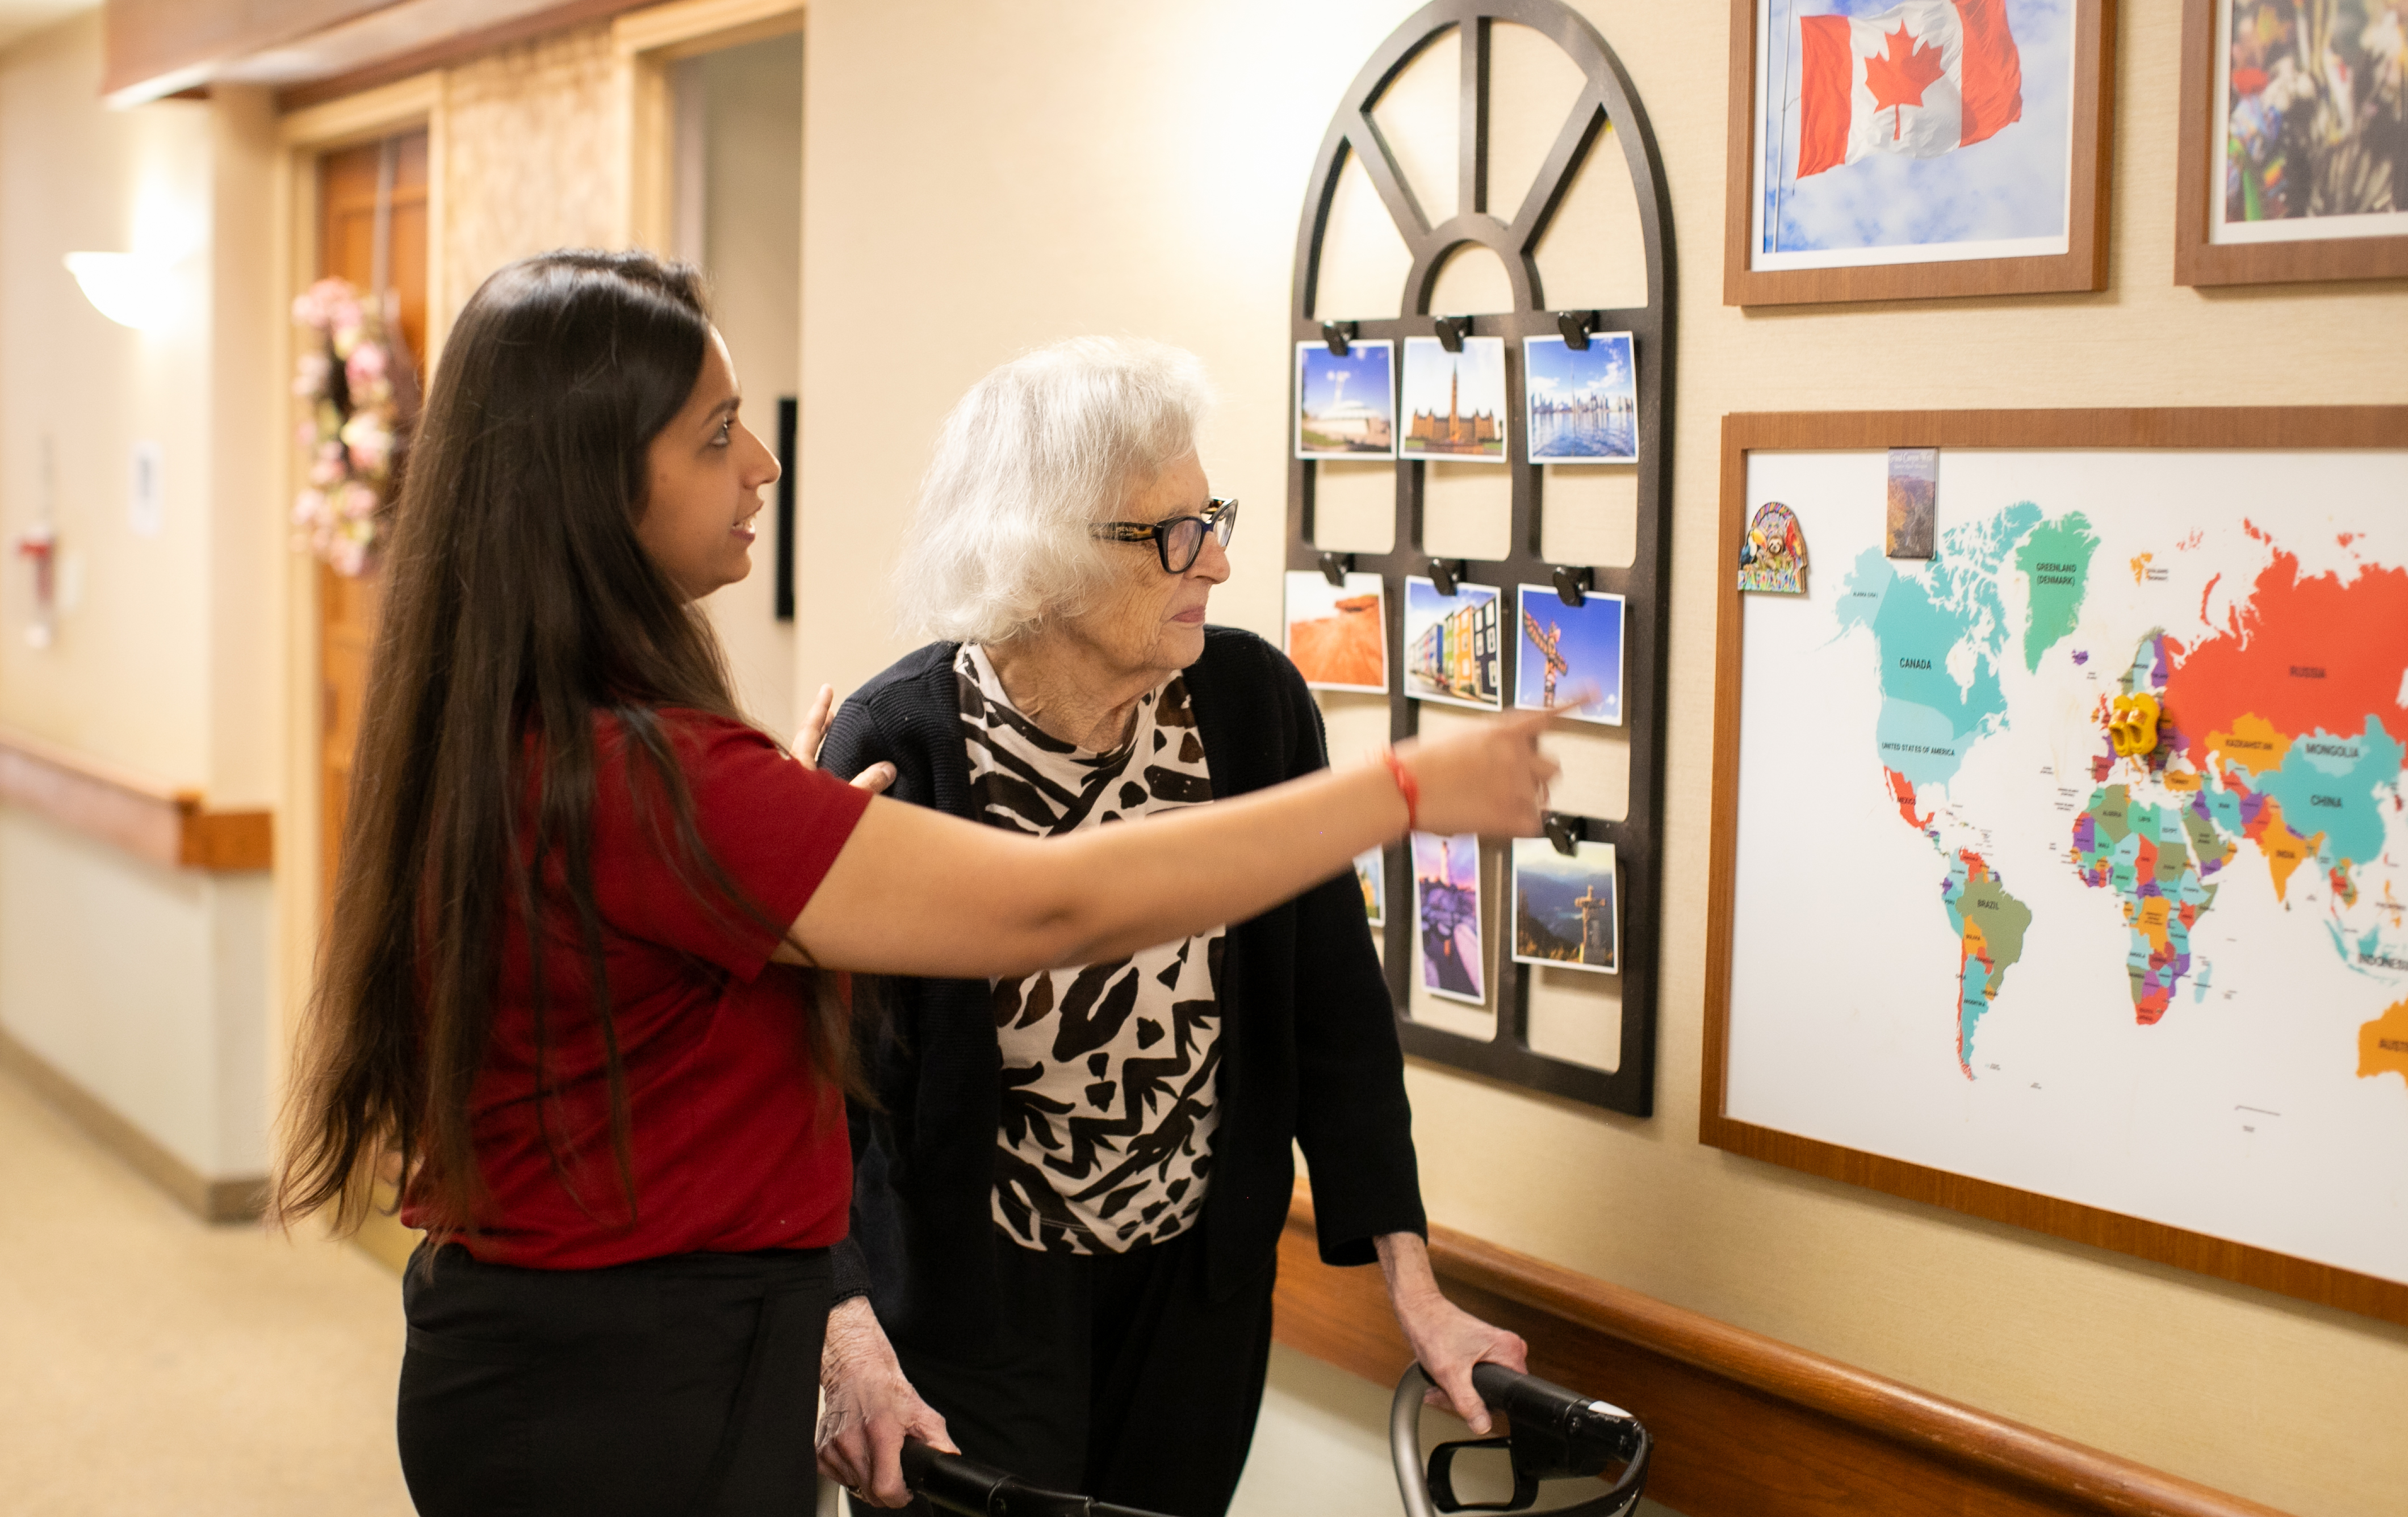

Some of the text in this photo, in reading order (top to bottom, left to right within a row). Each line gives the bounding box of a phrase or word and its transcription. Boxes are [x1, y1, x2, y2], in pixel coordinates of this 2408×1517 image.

[2036, 563, 2076, 573] GREENLAND
[2037, 575, 2075, 587] (DENMARK)
[1899, 657, 1932, 671] CANADA
[1882, 741, 1955, 756] UNITED STATES OF AMERICA
[2306, 744, 2359, 758] MONGOLIA
[2310, 794, 2342, 808] CHINA
[1977, 899, 1999, 911] BRAZIL
